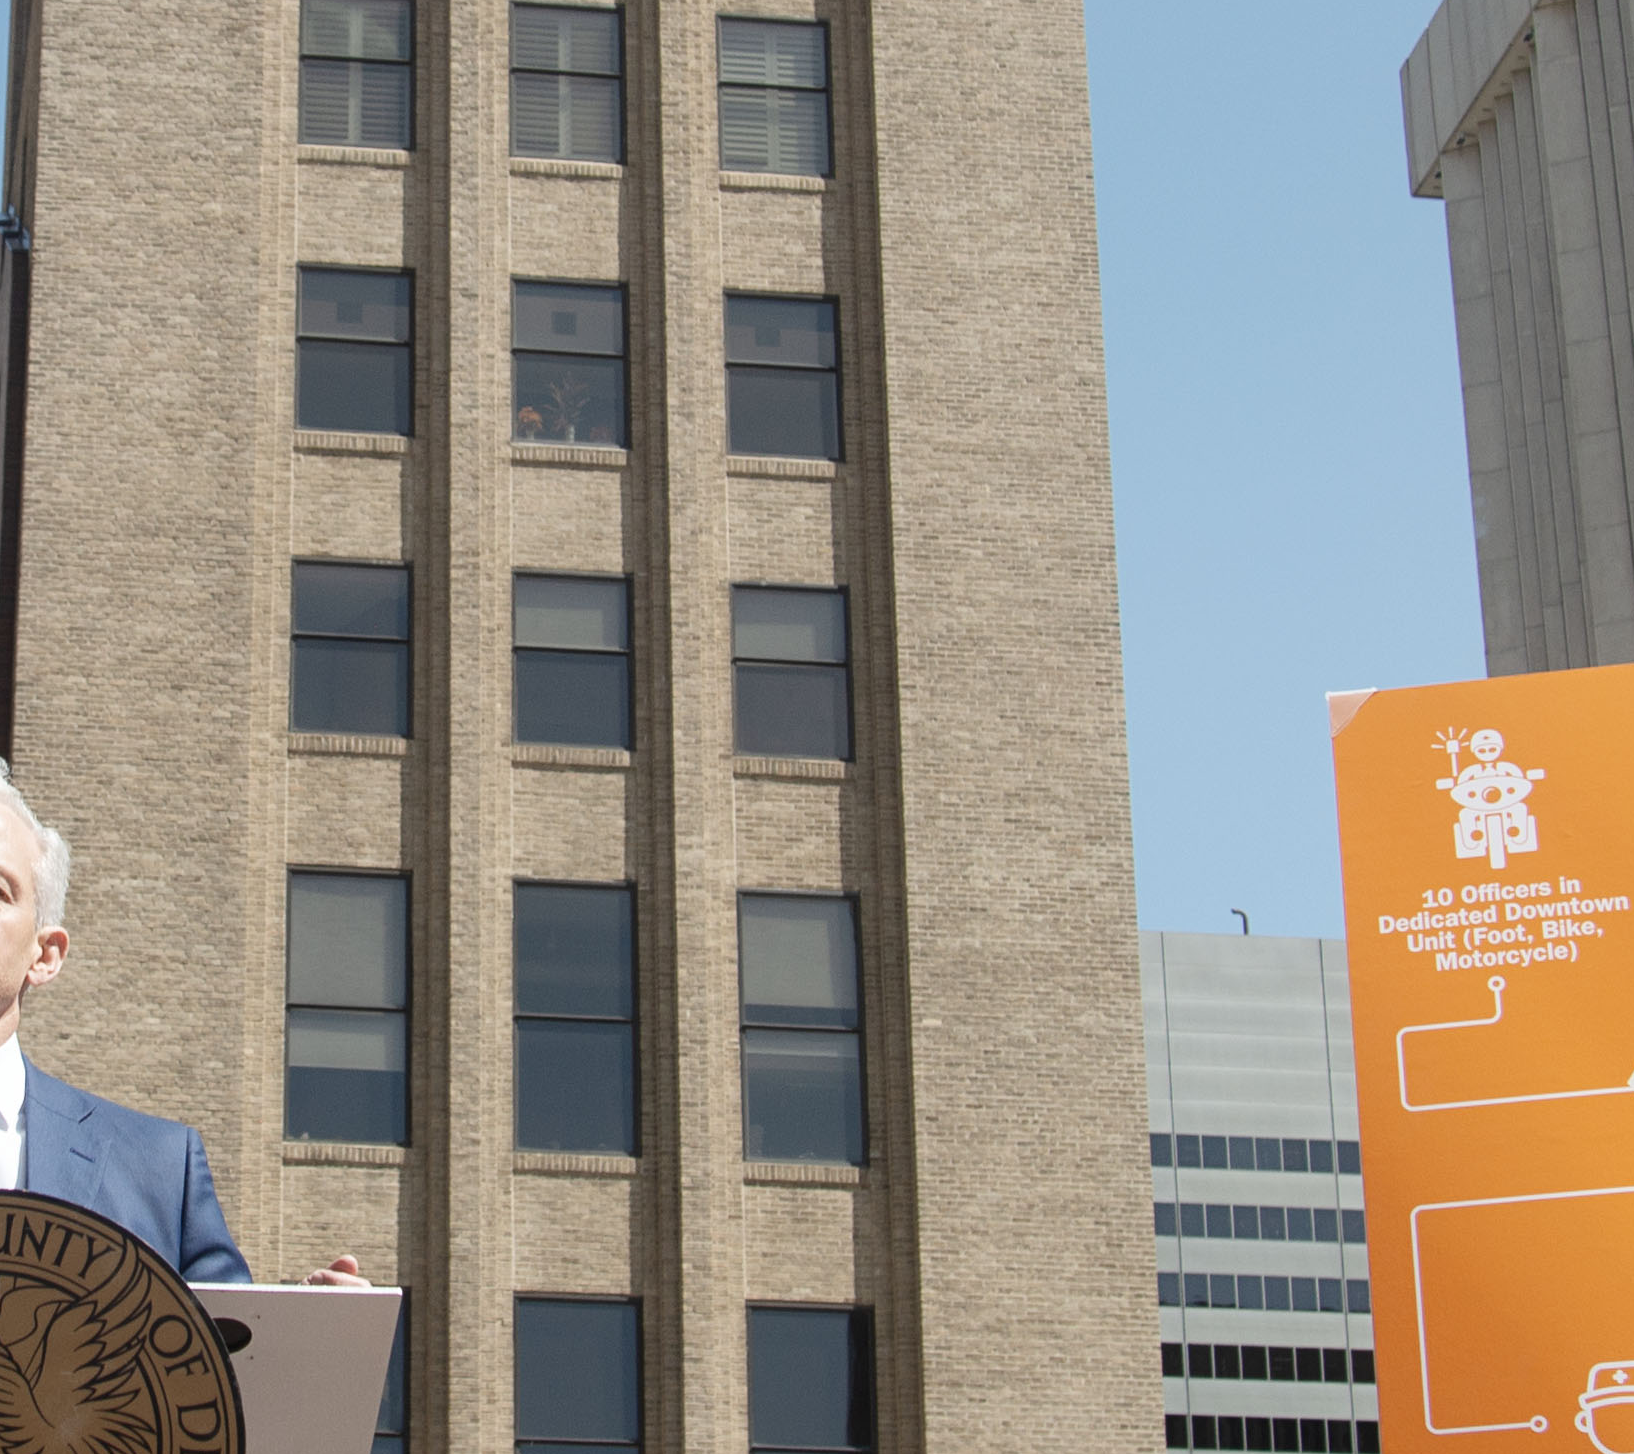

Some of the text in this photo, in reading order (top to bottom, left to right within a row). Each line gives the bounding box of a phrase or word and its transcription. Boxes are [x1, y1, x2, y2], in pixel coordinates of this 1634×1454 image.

[1422, 876, 1582, 909] 10 Officers in
[1378, 895, 1631, 934] Dedicated Downtown
[1407, 918, 1604, 953] Unit (Foot, Bike,
[1435, 940, 1579, 972] Motorcycle)
[150, 1314, 209, 1378] OF
